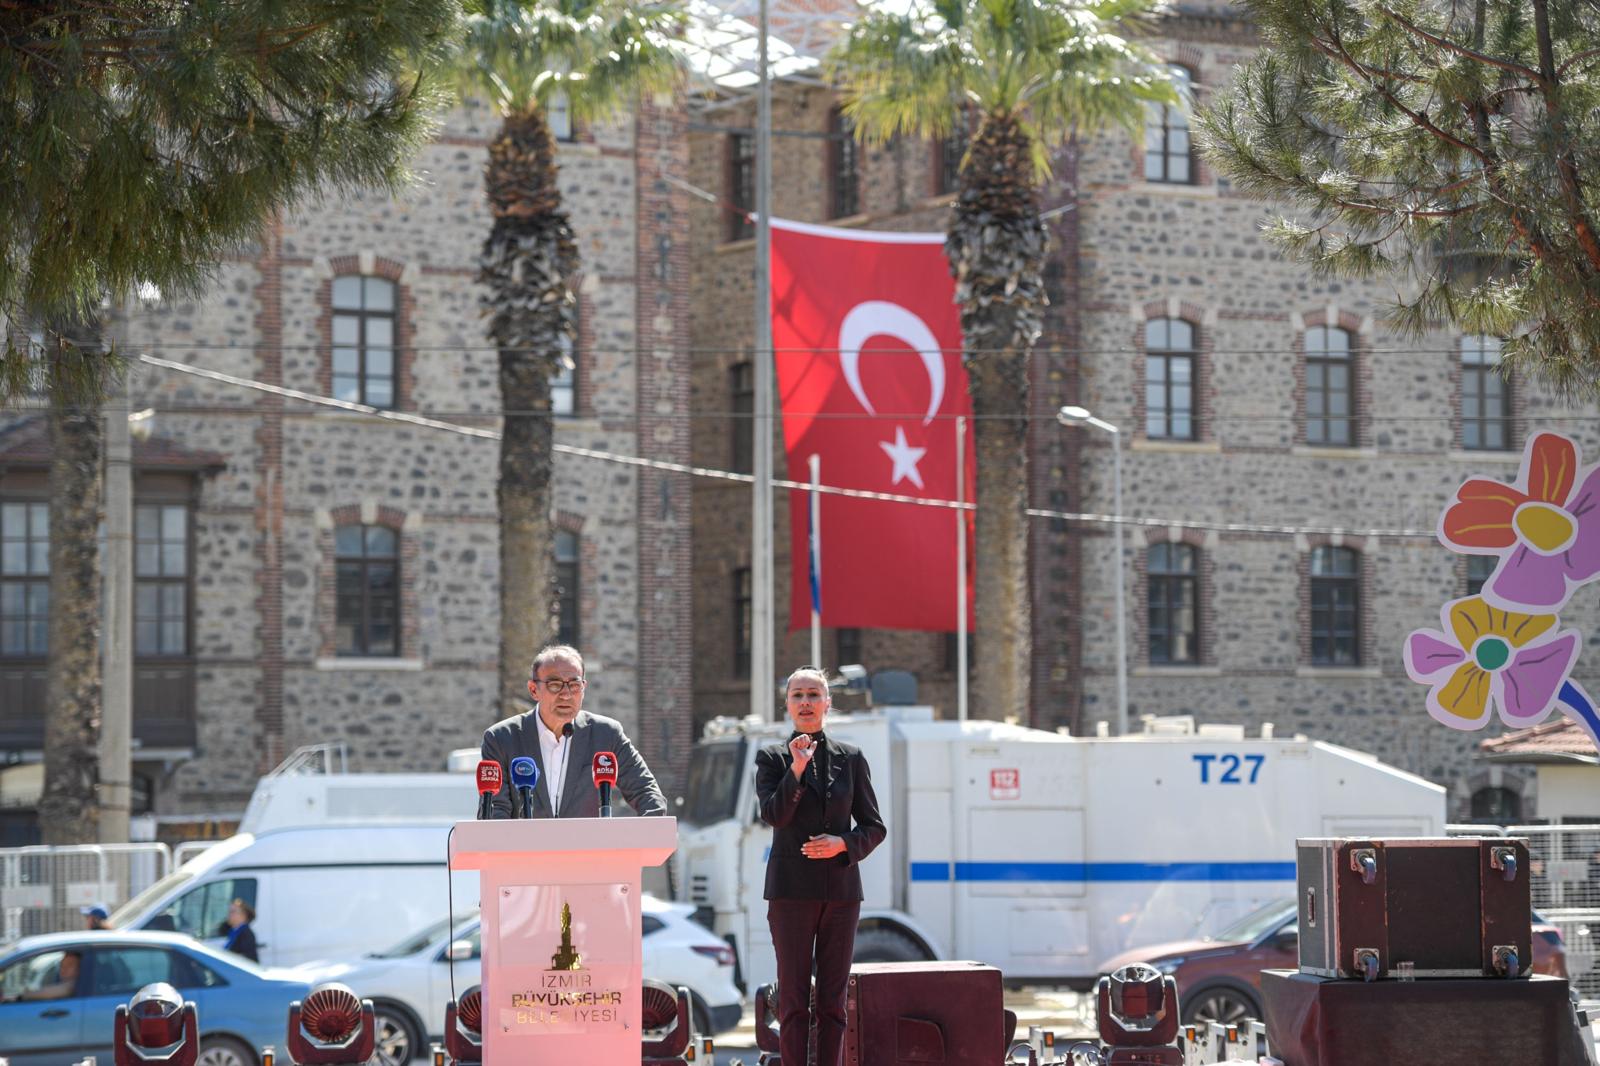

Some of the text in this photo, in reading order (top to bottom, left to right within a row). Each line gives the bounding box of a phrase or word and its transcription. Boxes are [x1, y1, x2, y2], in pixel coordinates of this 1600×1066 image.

[1192, 754, 1265, 783] T27
[541, 973, 592, 988] İZMİR
[511, 989, 622, 1008] BÜYÜKŞEHİR
[517, 1008, 617, 1024] BELEİYESİ
